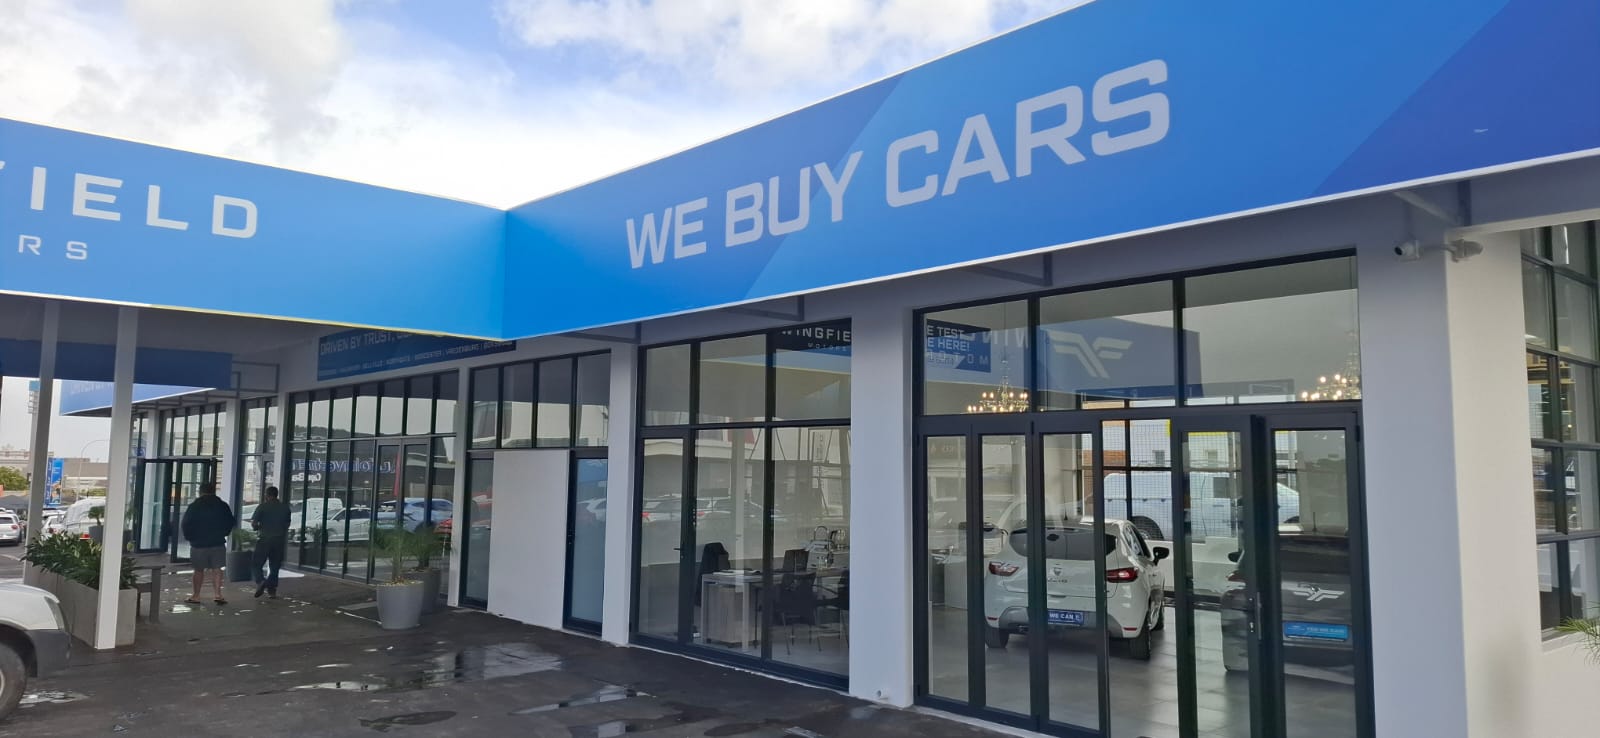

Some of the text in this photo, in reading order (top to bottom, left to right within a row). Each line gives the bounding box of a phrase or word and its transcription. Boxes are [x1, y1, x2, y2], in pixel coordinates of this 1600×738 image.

[626, 59, 1170, 269] WE BUY CARS
[0, 160, 258, 239] IELD
[937, 326, 965, 339] TEST
[320, 338, 349, 356] DRIVEN
[350, 335, 361, 350] BY
[938, 339, 970, 352] HERE!
